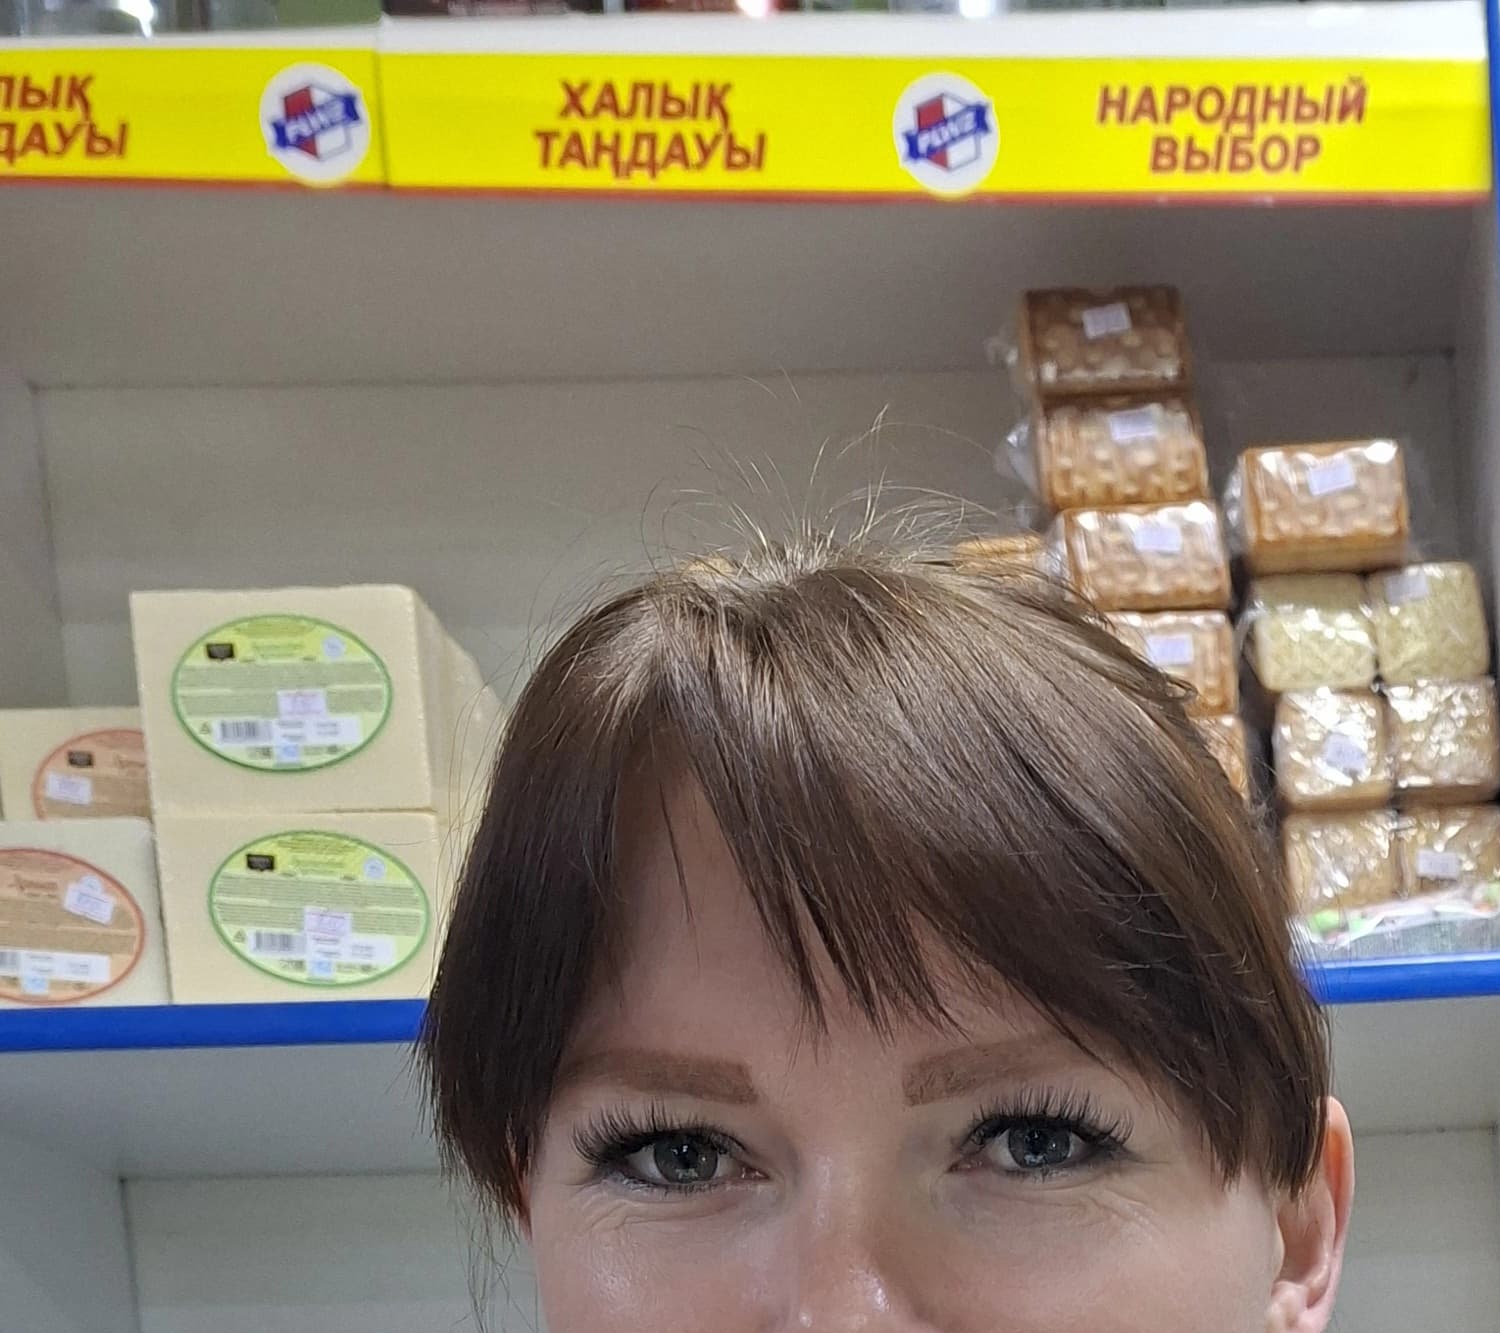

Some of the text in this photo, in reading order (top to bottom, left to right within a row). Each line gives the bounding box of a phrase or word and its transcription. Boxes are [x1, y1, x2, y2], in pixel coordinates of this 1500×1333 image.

[559, 81, 733, 130] ХАЛЫҚ
[1098, 76, 1368, 137] НАРОДНЫЙ
[534, 130, 767, 179] ТАҢДАУЫ
[1151, 134, 1321, 173] ВЫБОР
